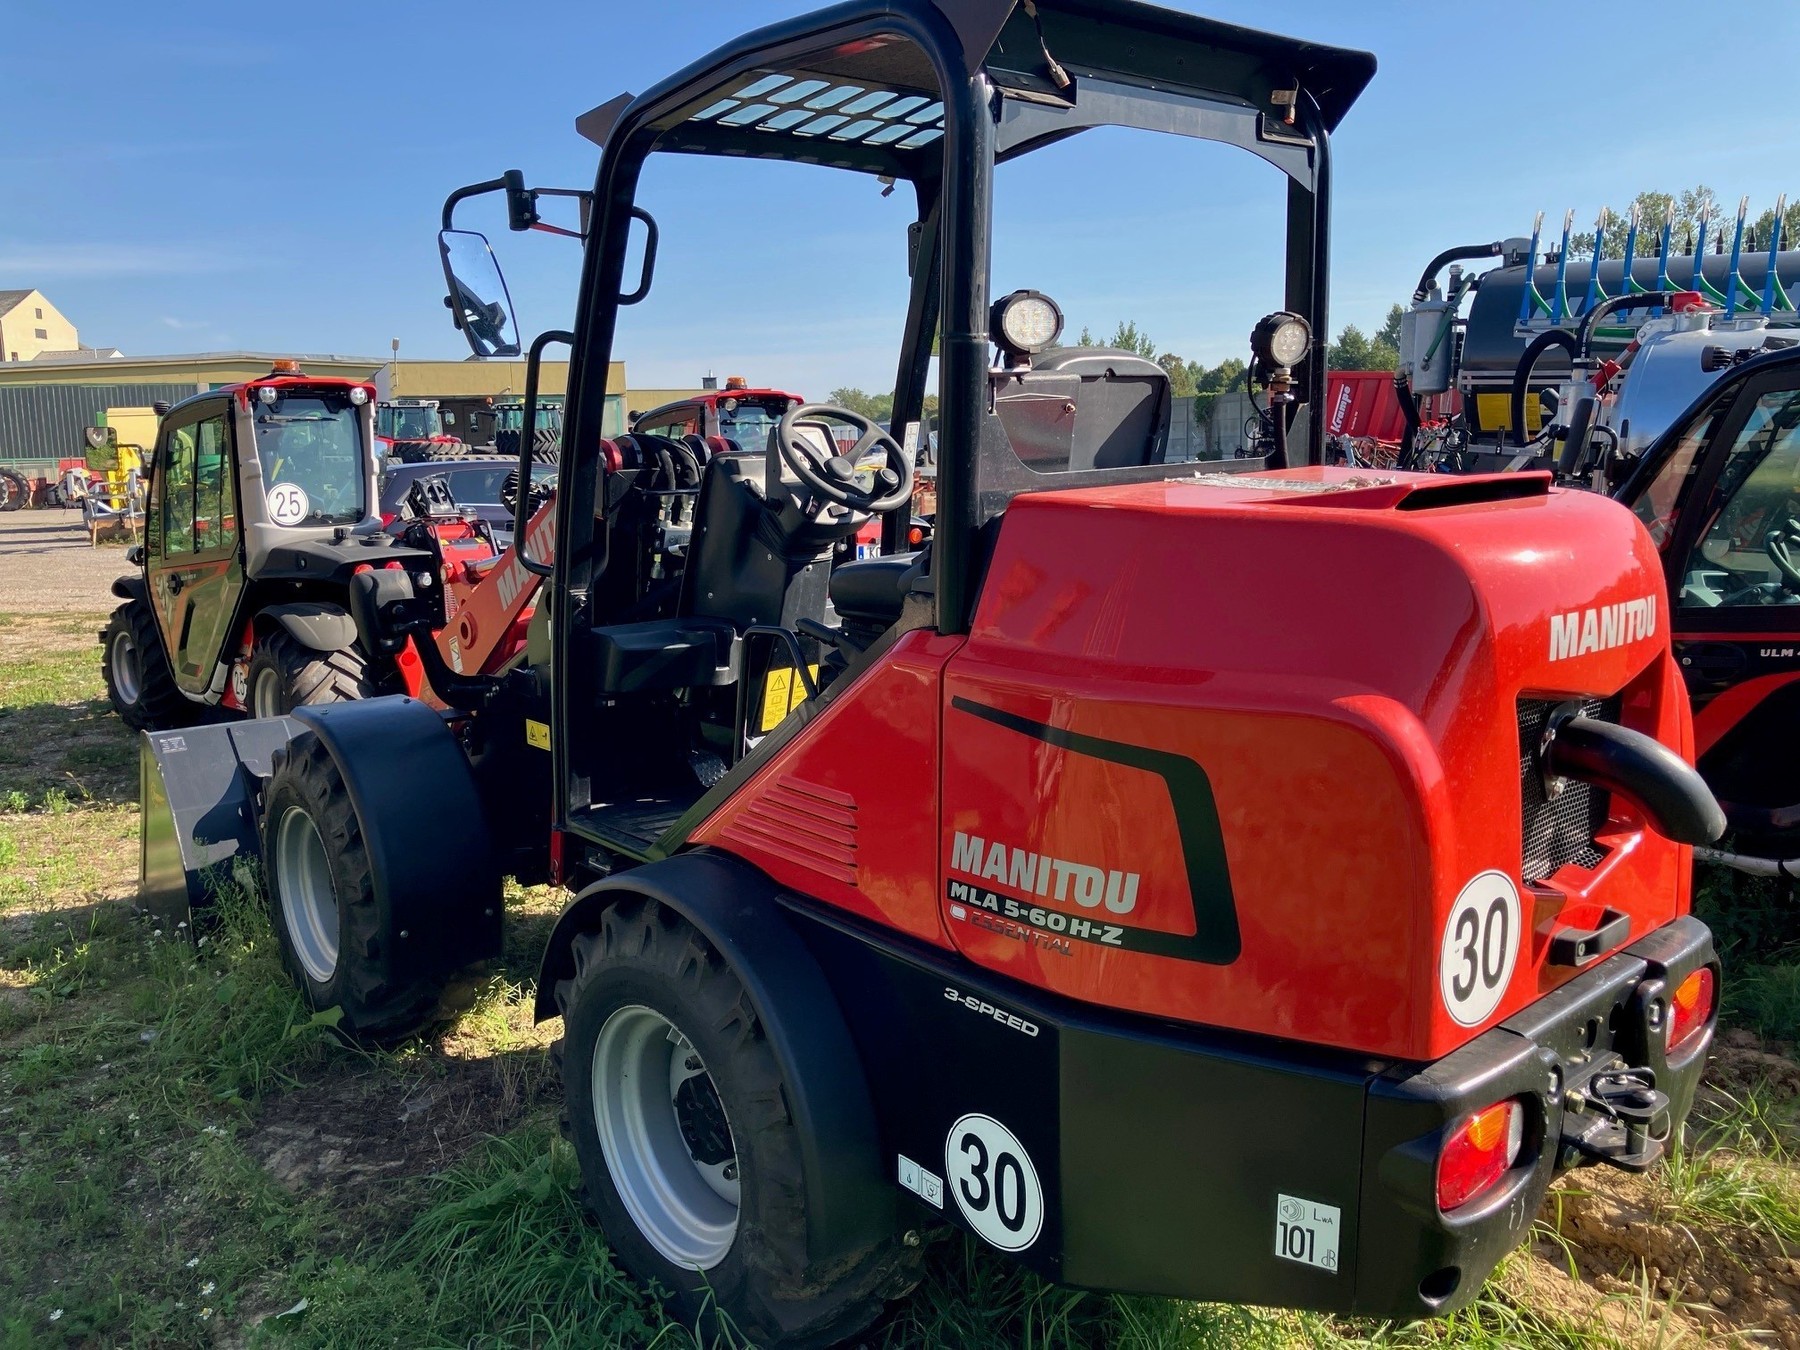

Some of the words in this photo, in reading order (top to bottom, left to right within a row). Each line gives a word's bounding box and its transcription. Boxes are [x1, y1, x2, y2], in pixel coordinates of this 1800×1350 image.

[275, 491, 301, 518] 25
[1548, 593, 1657, 662] MANITOU
[1760, 648, 1794, 658] ULM
[950, 881, 999, 912] MLA
[951, 831, 1140, 915] MANITOU
[970, 910, 1073, 957] ESSENTIAL
[1452, 896, 1509, 1003] 30
[943, 986, 1040, 1038] 3-SPEED
[959, 1132, 1027, 1233] 30
[1279, 1221, 1315, 1263] 101
[1320, 1248, 1337, 1268] dB
